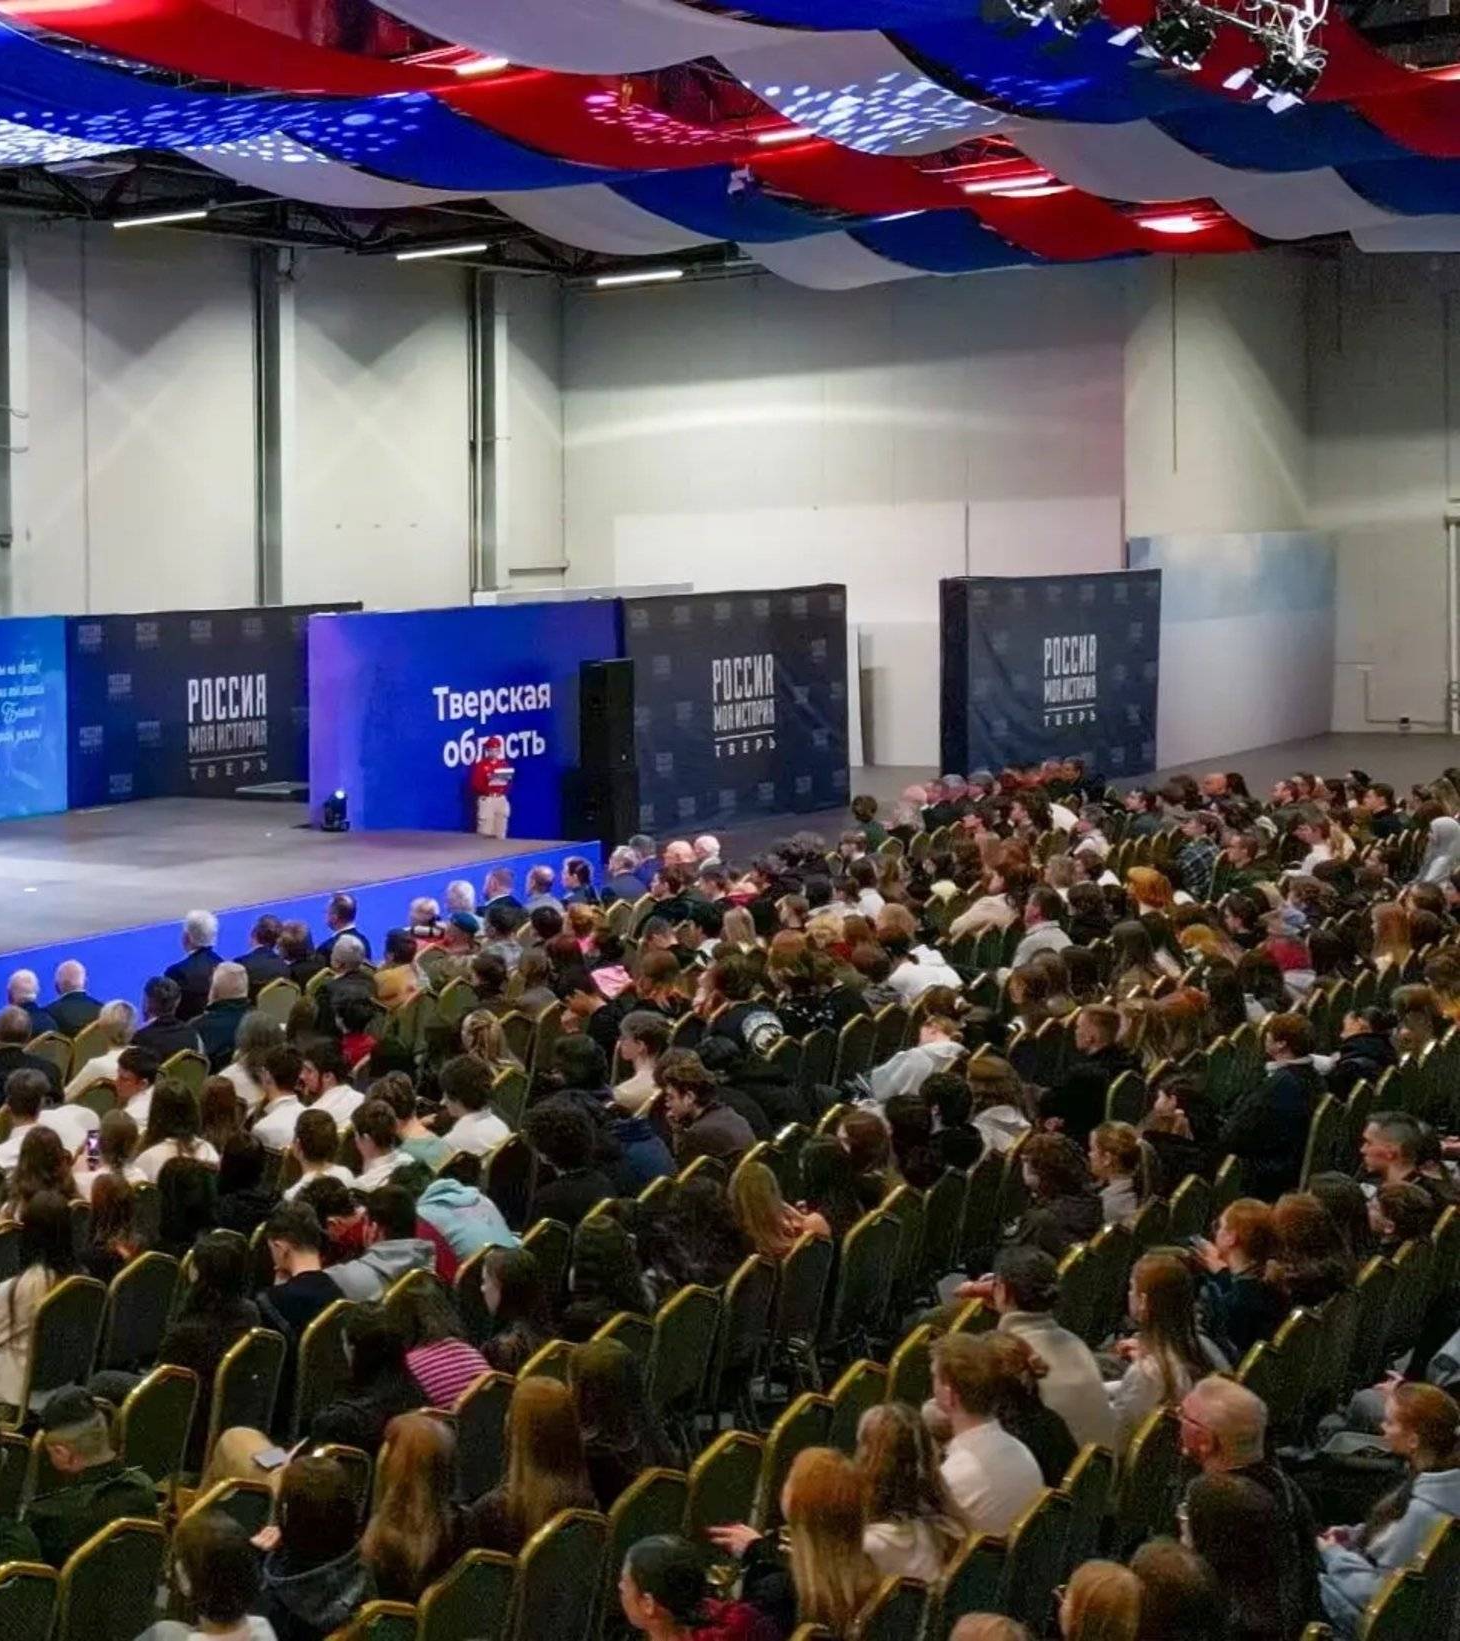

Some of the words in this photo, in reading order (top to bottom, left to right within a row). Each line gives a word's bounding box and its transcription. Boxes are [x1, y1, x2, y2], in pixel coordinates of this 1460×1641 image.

[1044, 634, 1096, 677] РОССИЯ
[188, 674, 267, 723] РОССИЯ
[712, 654, 774, 703] РОССИЯ
[433, 684, 551, 724] Тверская
[188, 724, 215, 753] МОЯ
[217, 720, 268, 751] ИСТОРИЯ
[715, 736, 776, 757] ТВЕРЬ
[190, 759, 267, 779] ТВЕРЬ
